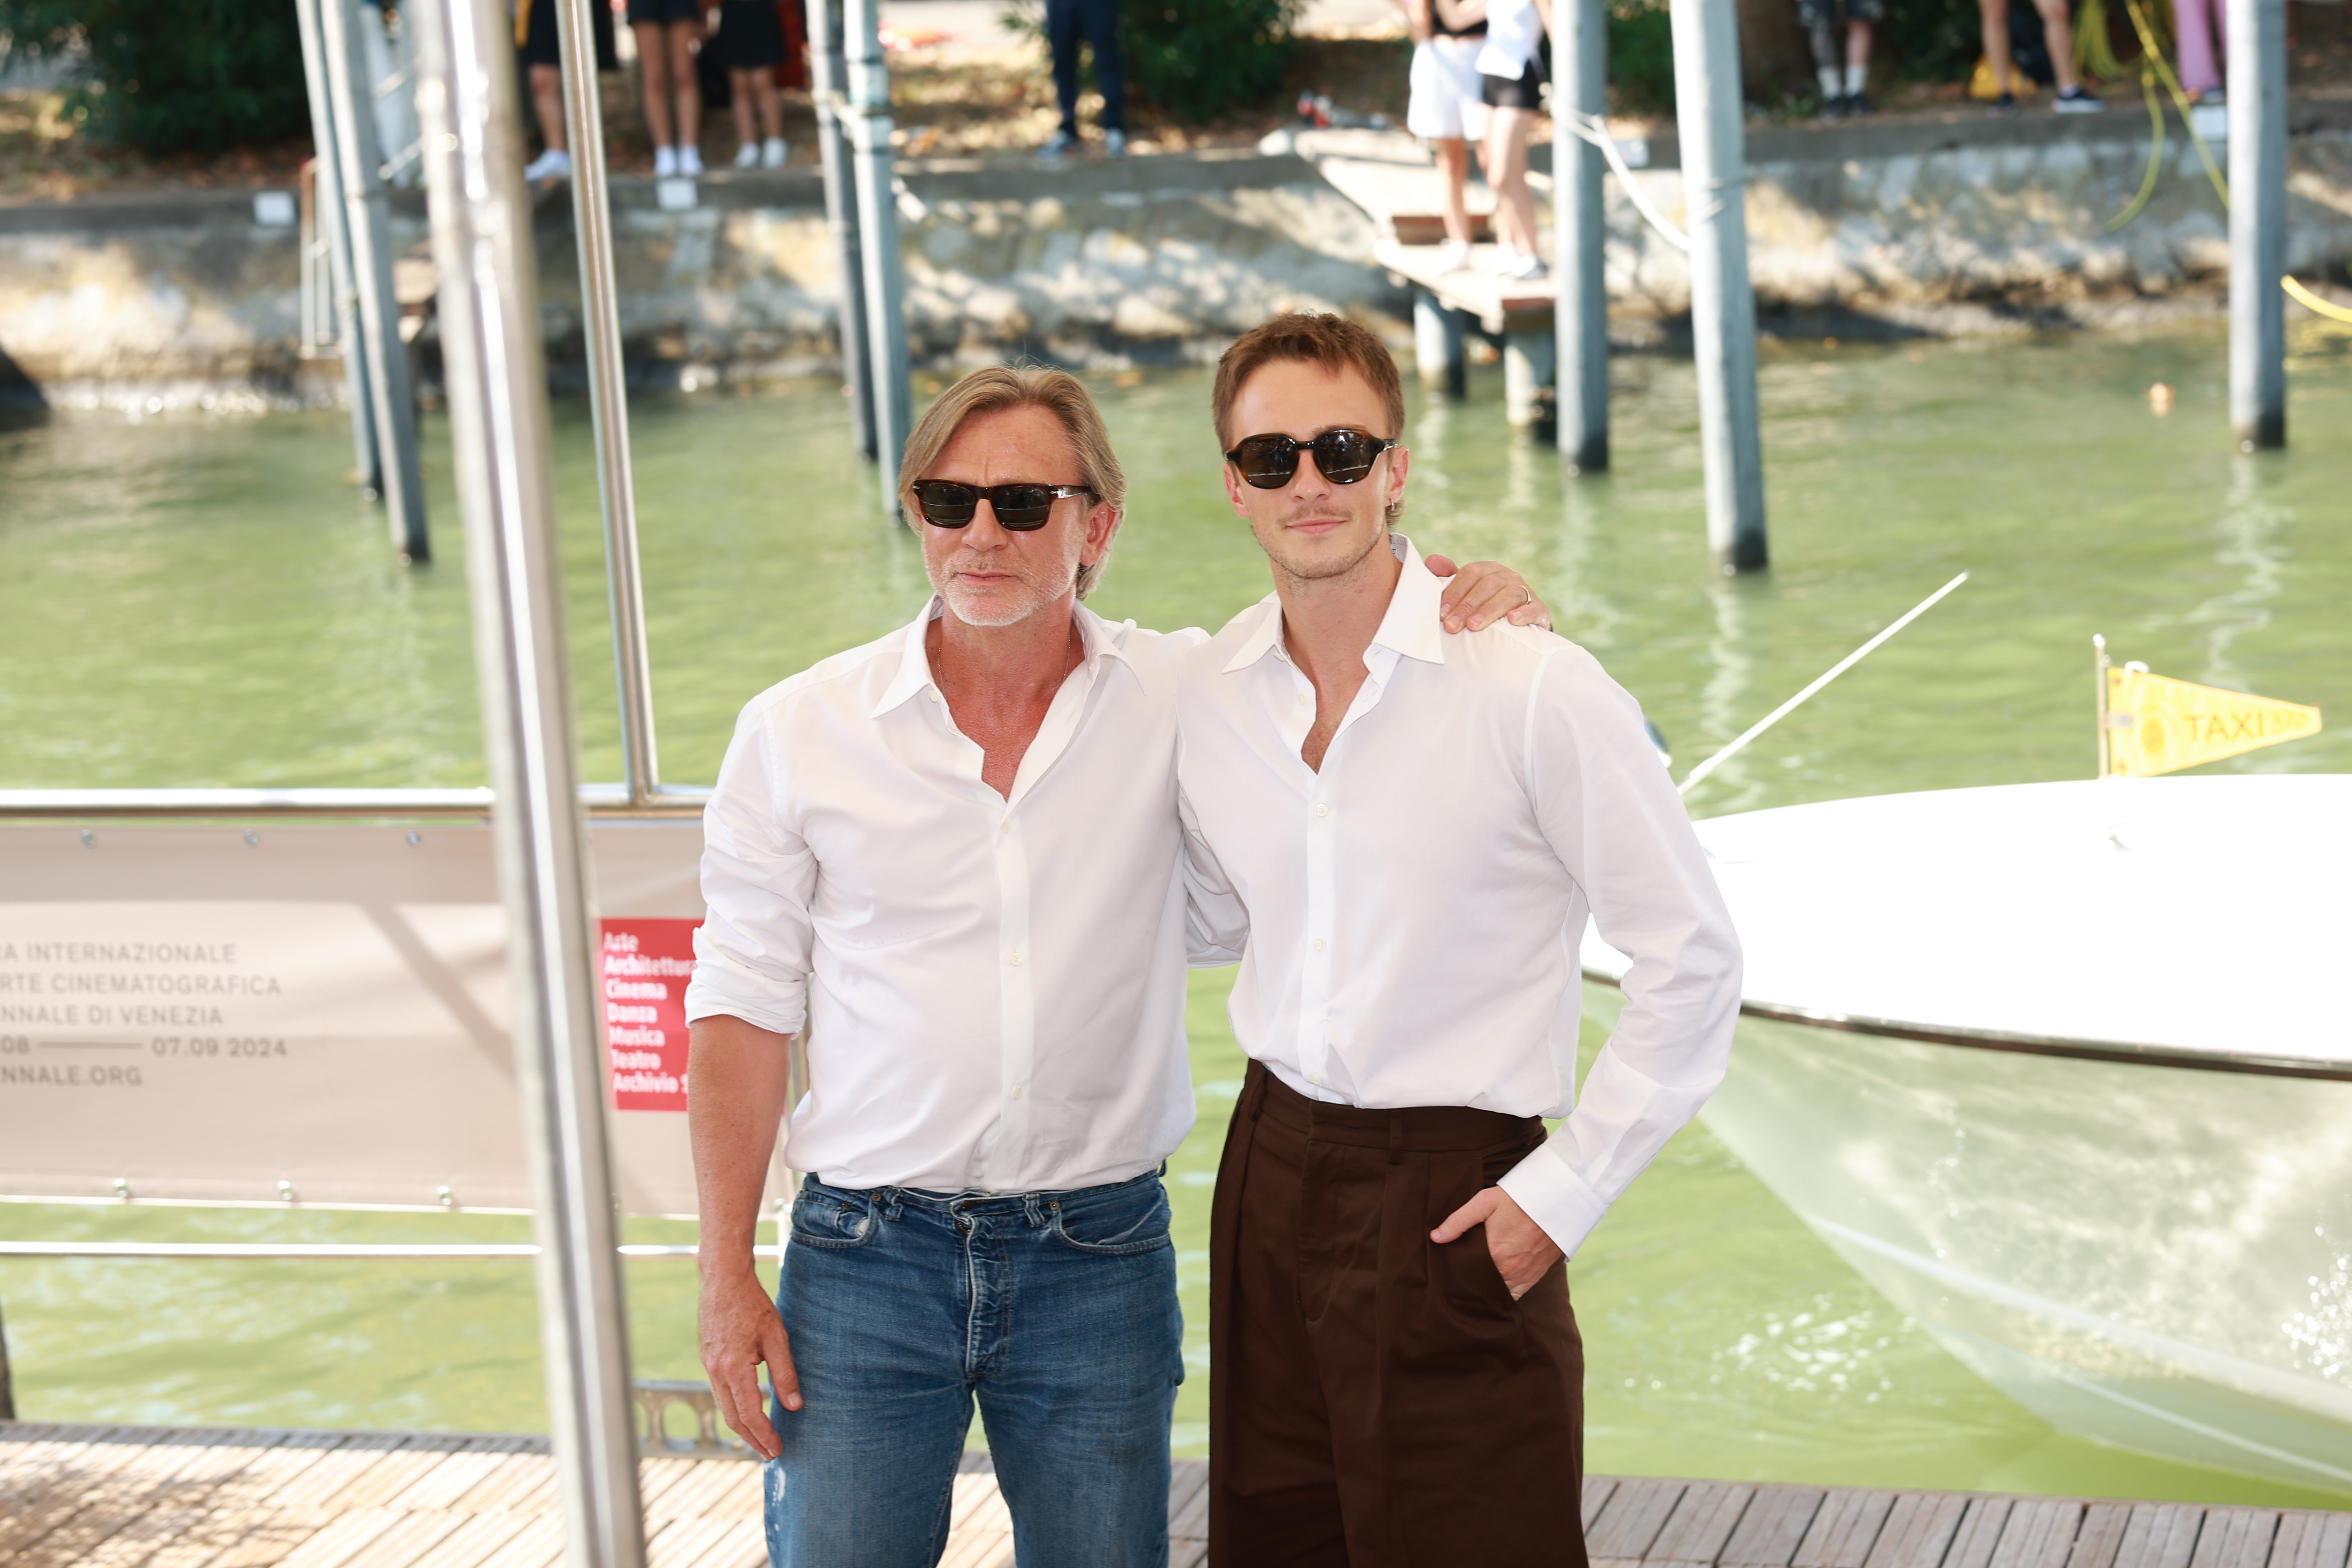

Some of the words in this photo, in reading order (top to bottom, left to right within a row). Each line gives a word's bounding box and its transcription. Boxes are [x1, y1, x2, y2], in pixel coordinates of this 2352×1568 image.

[2184, 711, 2264, 741] TAXI
[604, 932, 639, 952] Arte
[26, 943, 236, 963] INTERNAZIONALE
[51, 974, 282, 995] CINEMATOGRAFICA
[606, 978, 667, 1000] Cinema
[88, 1005, 111, 1025] DI
[119, 1005, 223, 1025] VENEZIA
[608, 1002, 657, 1023] Danza
[610, 1025, 665, 1047] Musica
[152, 1037, 219, 1057] 07.09
[228, 1038, 287, 1057] 2024
[612, 1049, 661, 1070] Teatro
[614, 1071, 679, 1093] Archivio
